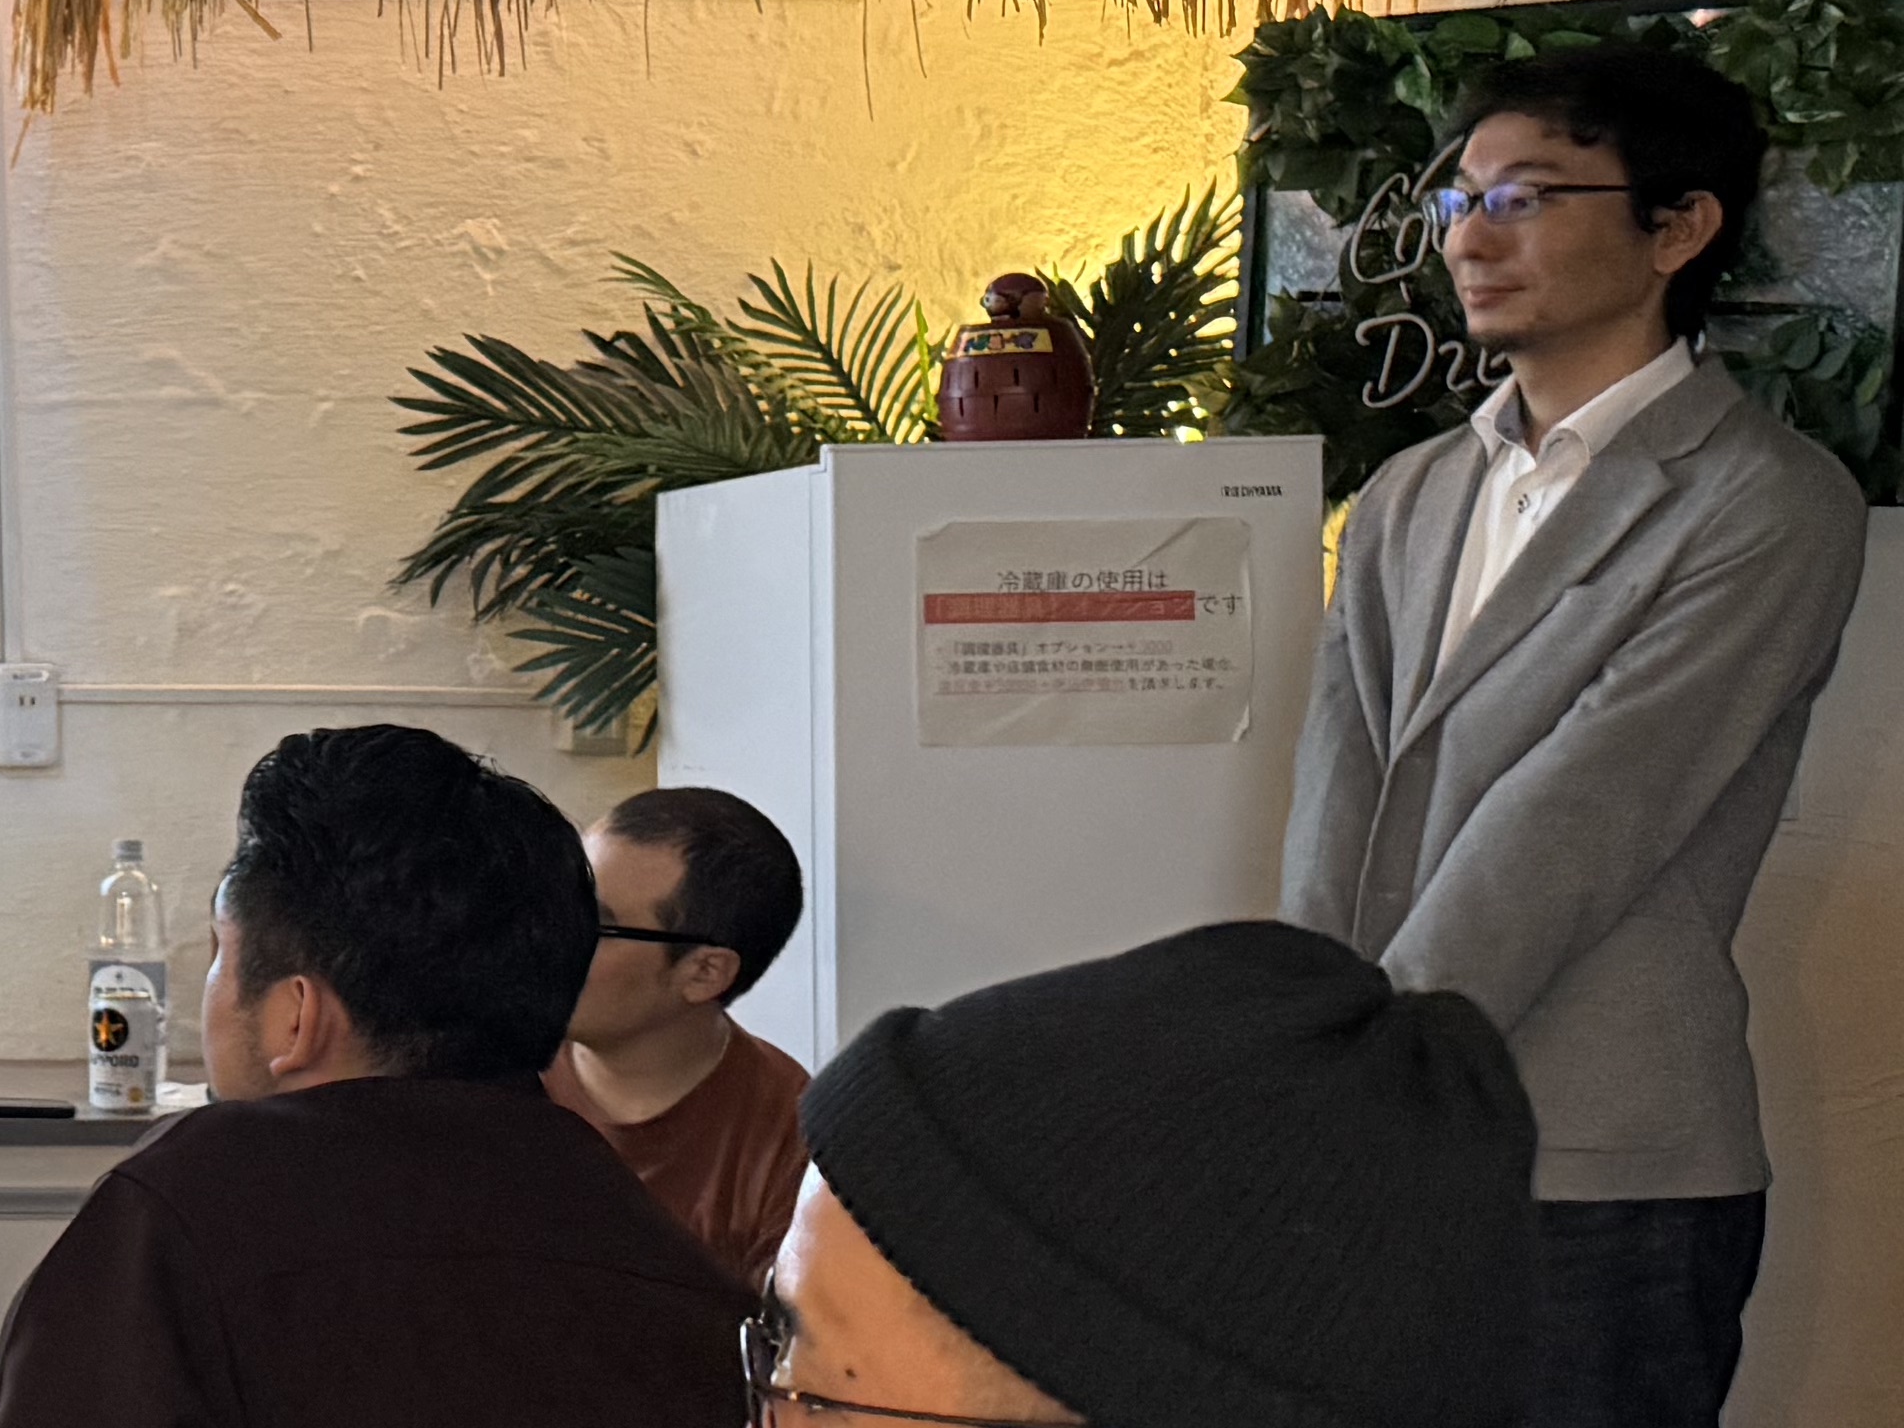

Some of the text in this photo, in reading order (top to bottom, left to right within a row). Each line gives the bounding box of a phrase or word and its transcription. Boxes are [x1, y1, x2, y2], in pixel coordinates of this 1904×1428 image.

[997, 569, 1168, 592] 冷蔵庫の使用は
